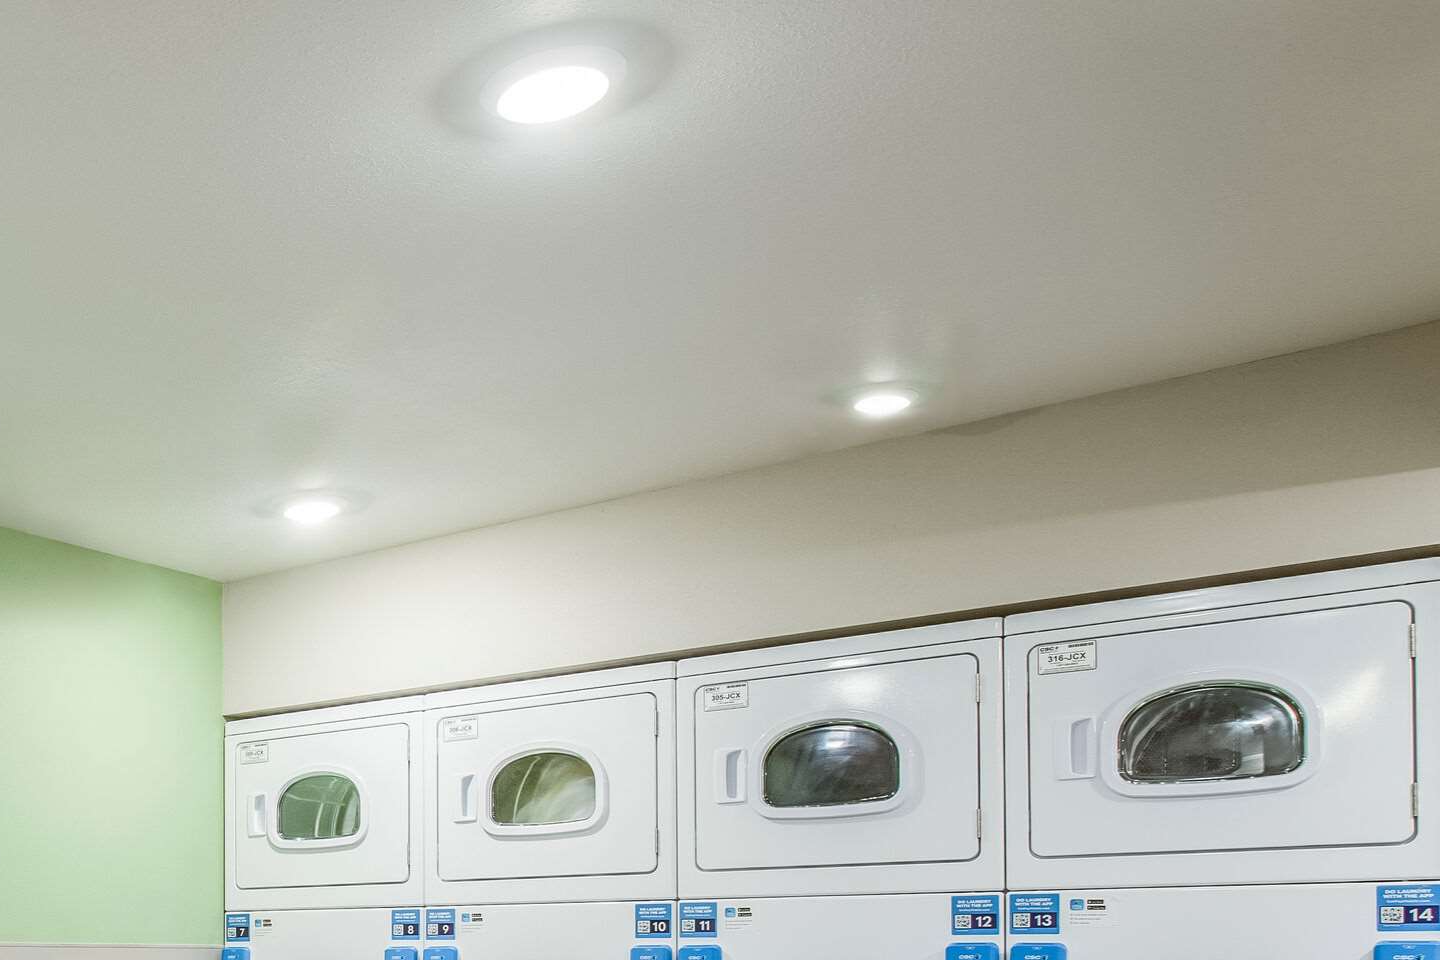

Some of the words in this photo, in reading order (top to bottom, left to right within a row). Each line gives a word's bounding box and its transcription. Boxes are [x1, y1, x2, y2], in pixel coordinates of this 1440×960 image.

[1409, 908, 1434, 922] 14
[975, 916, 992, 927] 12
[1034, 915, 1052, 926] 13
[407, 925, 414, 934] 8
[443, 925, 449, 934] 9
[652, 922, 666, 931] 10
[699, 921, 711, 931] 11
